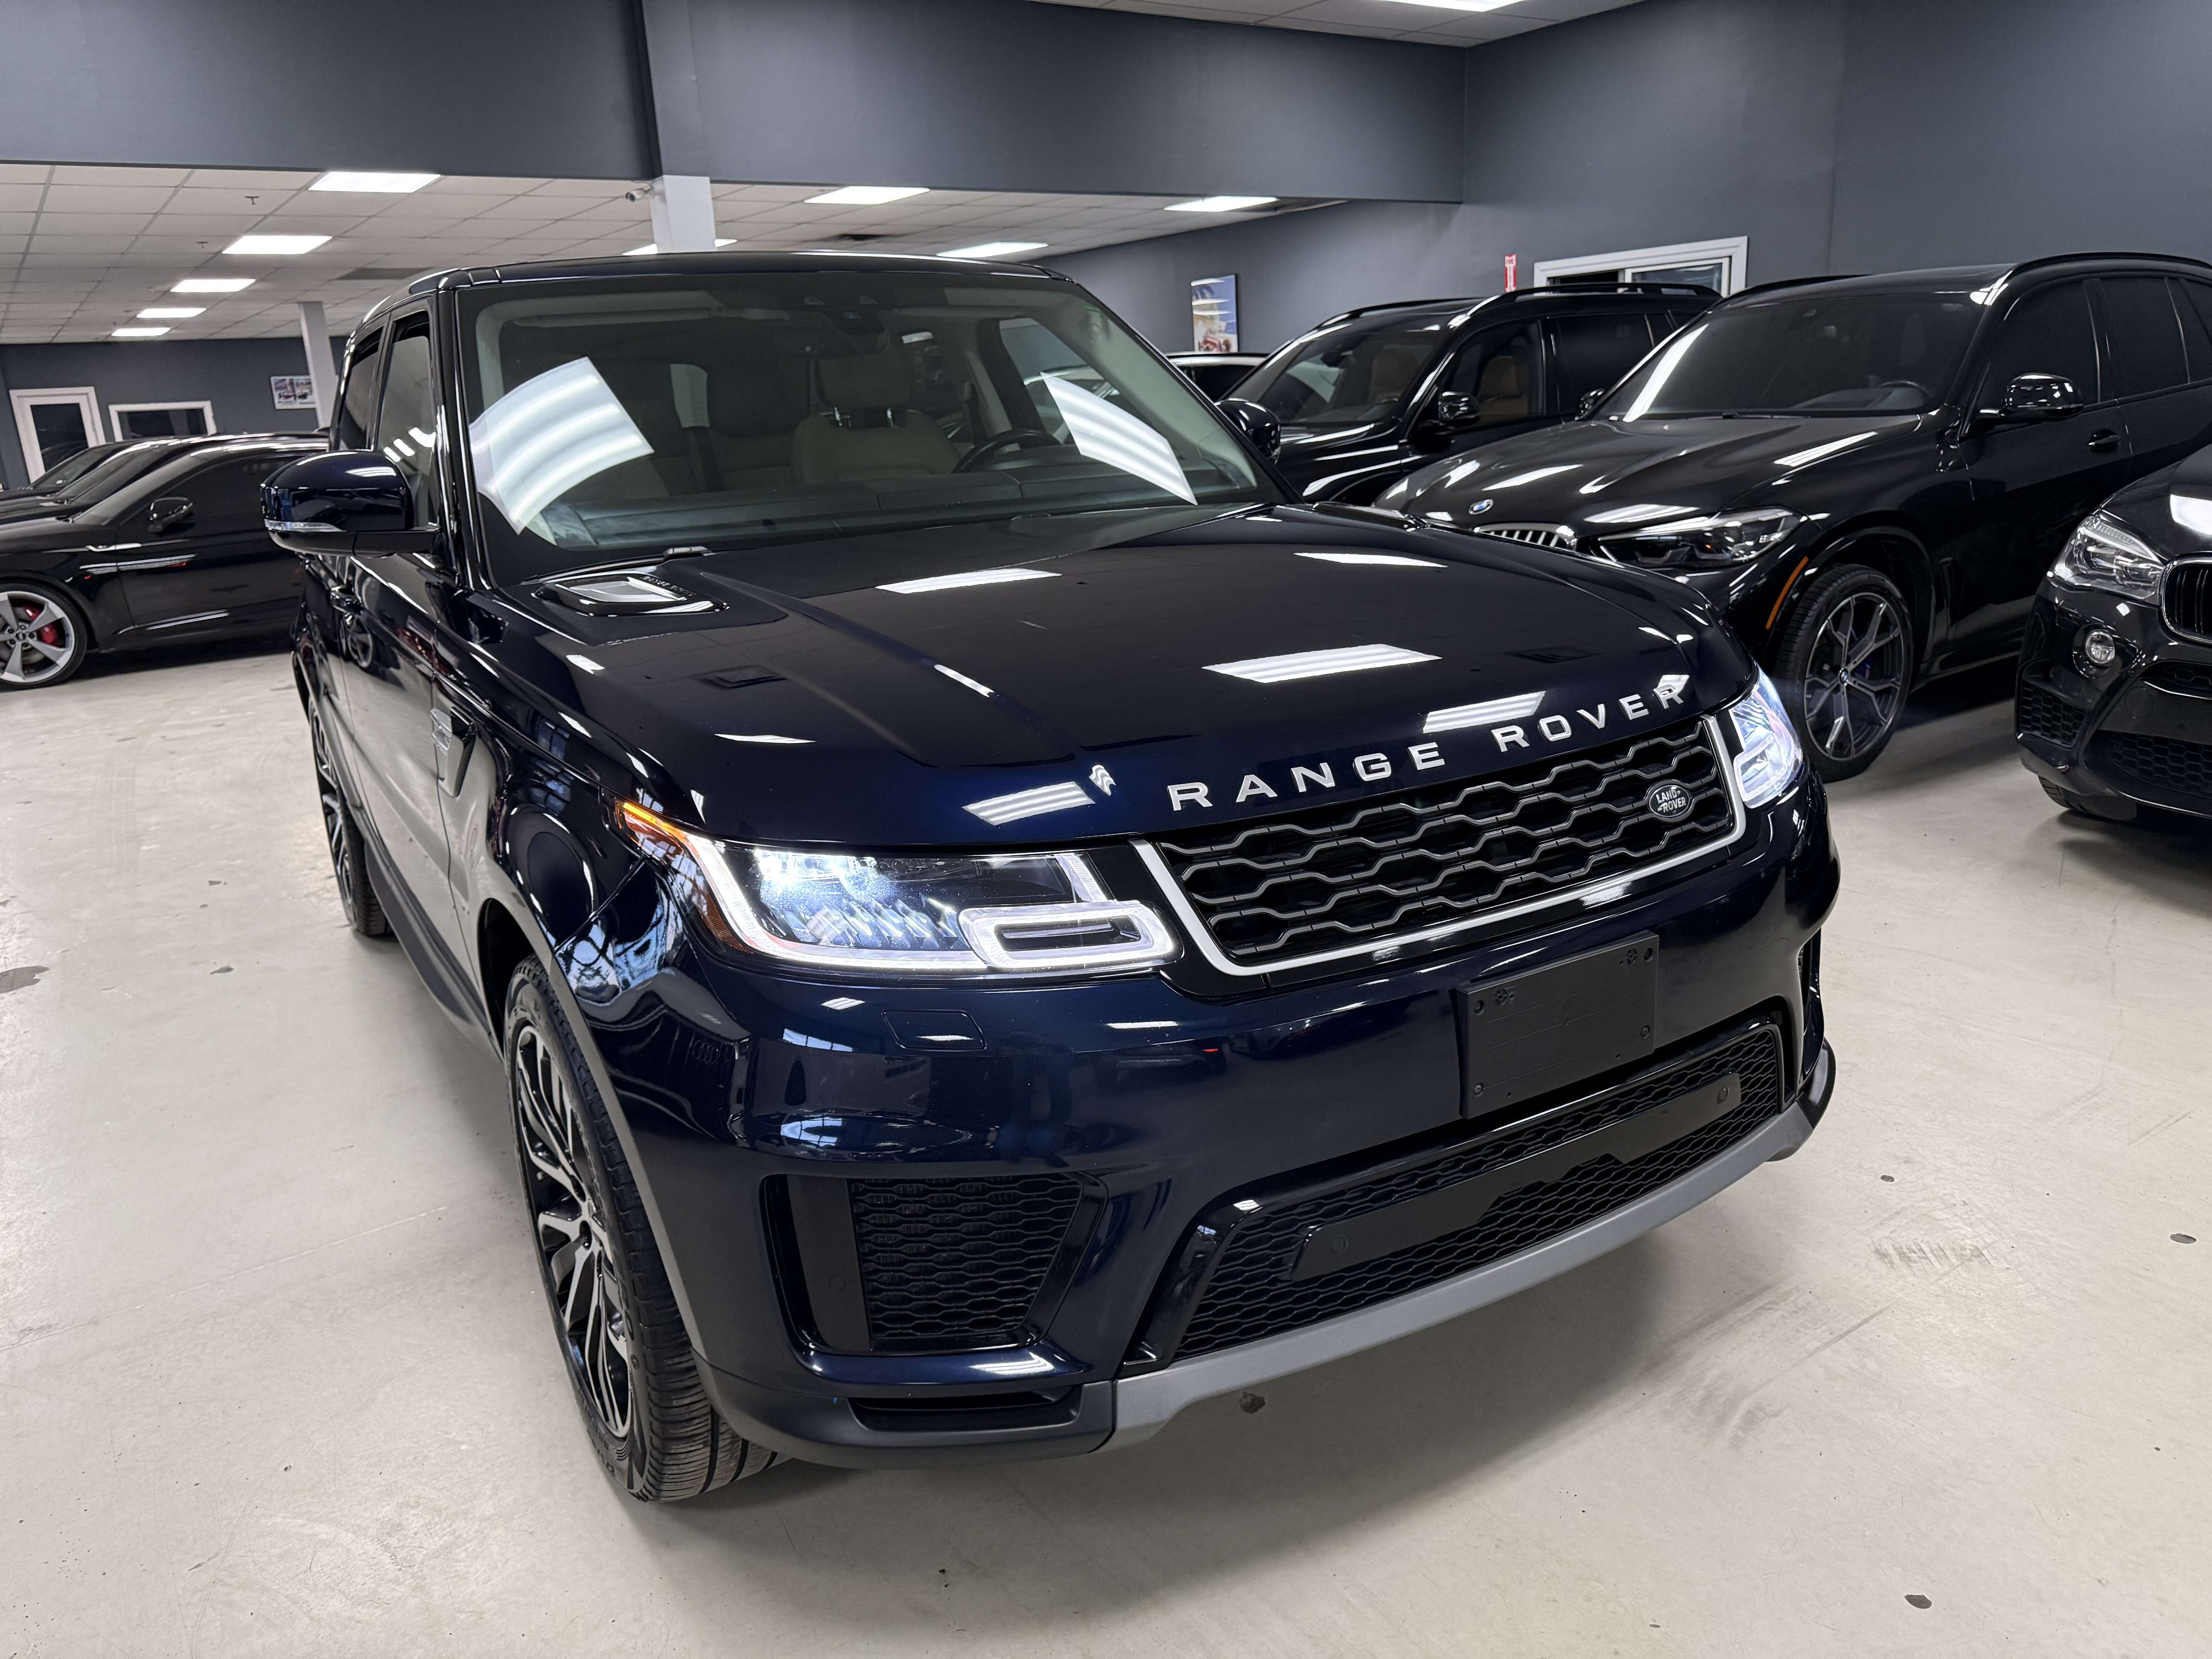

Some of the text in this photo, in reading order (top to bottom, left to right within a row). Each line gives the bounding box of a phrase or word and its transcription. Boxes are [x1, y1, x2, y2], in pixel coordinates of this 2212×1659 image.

[1167, 685, 1684, 811] RANGE ROVER
[1656, 790, 1678, 804] LAND
[1662, 797, 1686, 812] ROVER
